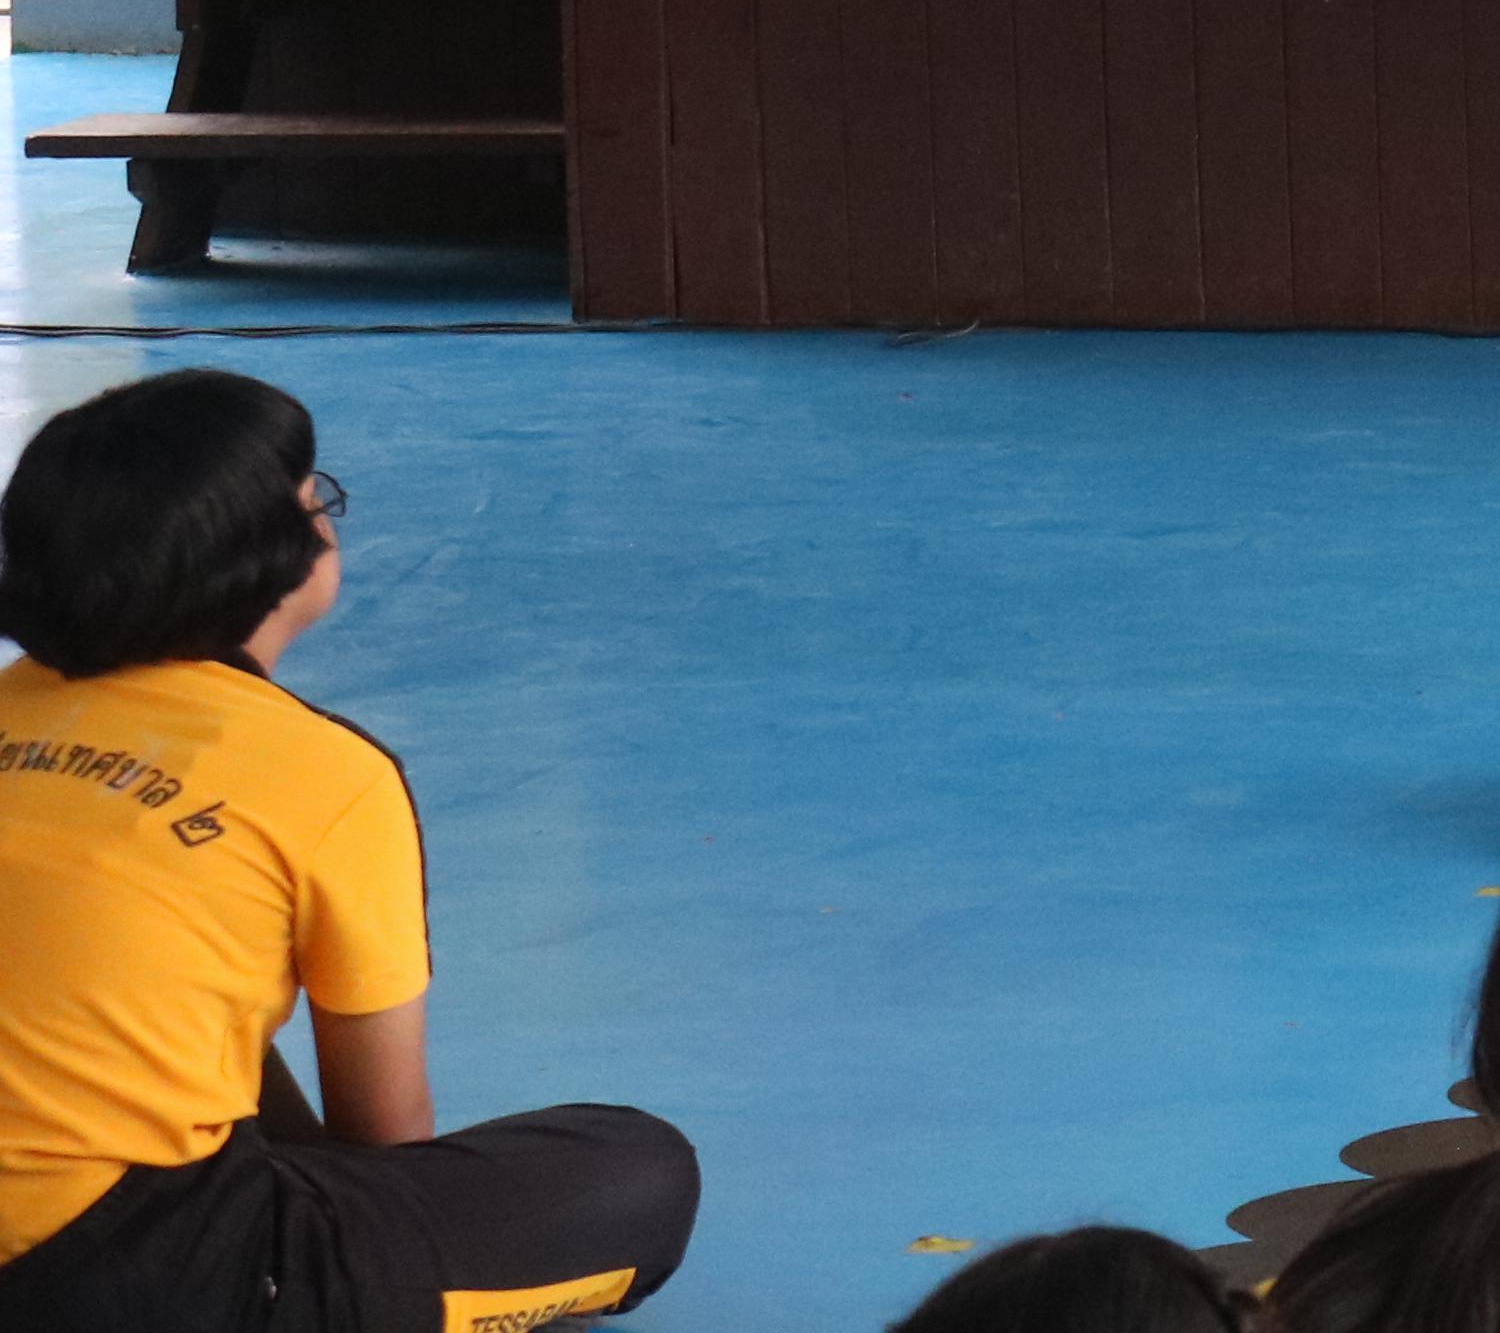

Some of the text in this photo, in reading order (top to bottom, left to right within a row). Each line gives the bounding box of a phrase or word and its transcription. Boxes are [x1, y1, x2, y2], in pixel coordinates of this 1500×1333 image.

[0, 730, 226, 848] ยนเทศบาล ๒
